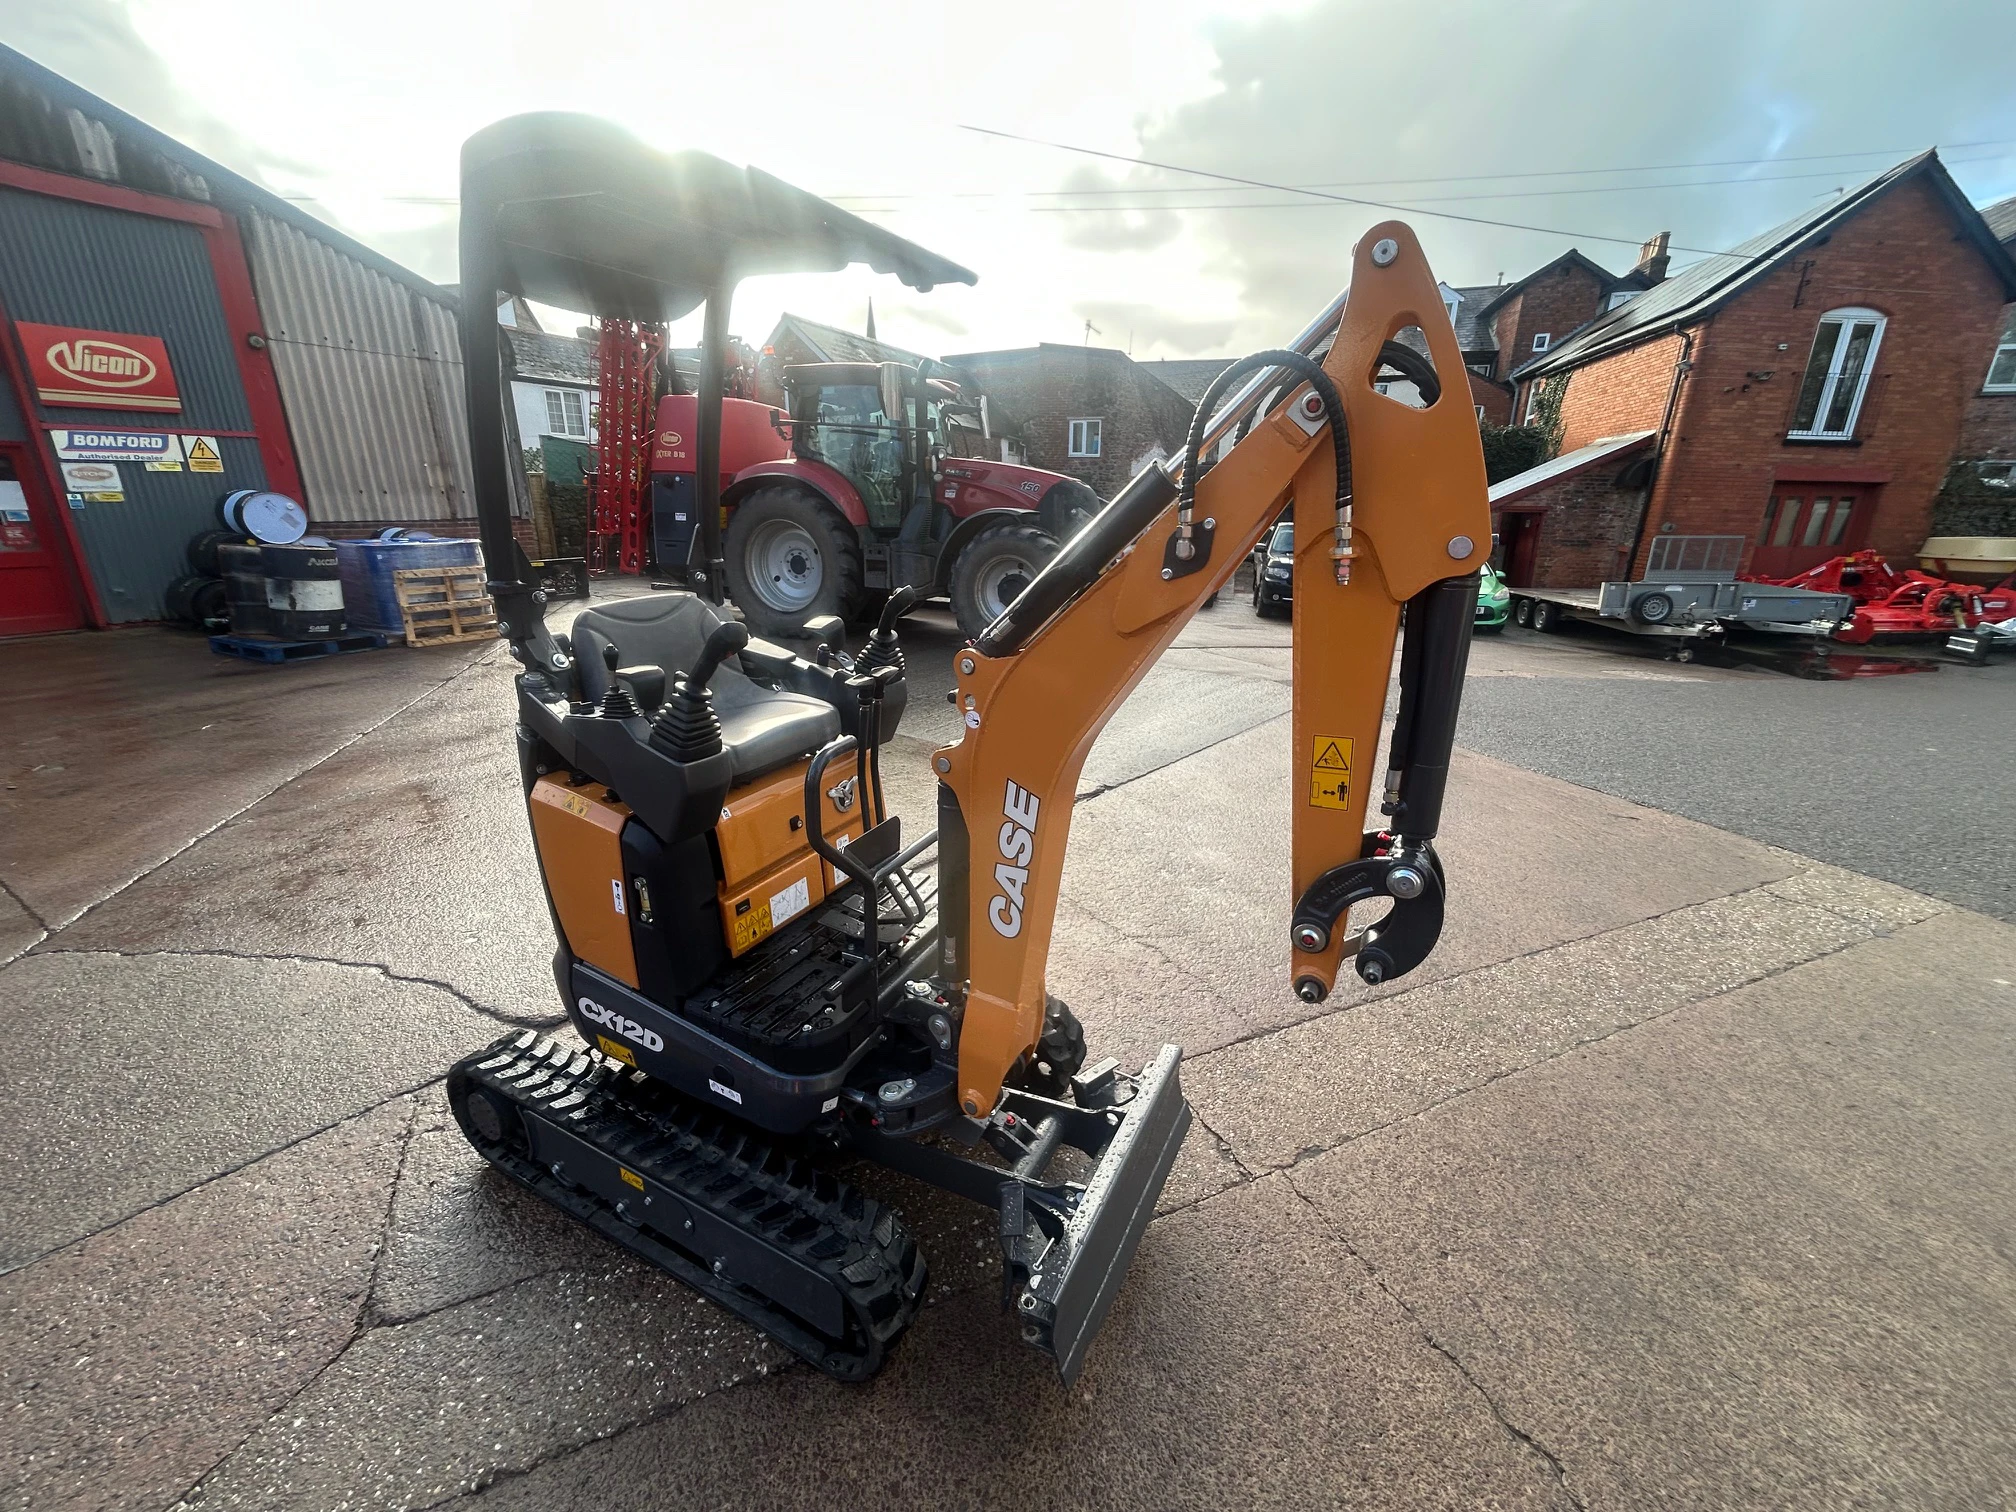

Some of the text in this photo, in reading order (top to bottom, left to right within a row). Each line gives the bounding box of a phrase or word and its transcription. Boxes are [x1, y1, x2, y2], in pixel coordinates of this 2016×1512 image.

[58, 340, 142, 377] Vicon
[73, 434, 163, 449] BOMFORD
[1020, 481, 1041, 493] 150
[988, 777, 1041, 939] CASE
[578, 996, 664, 1052] CX12D
